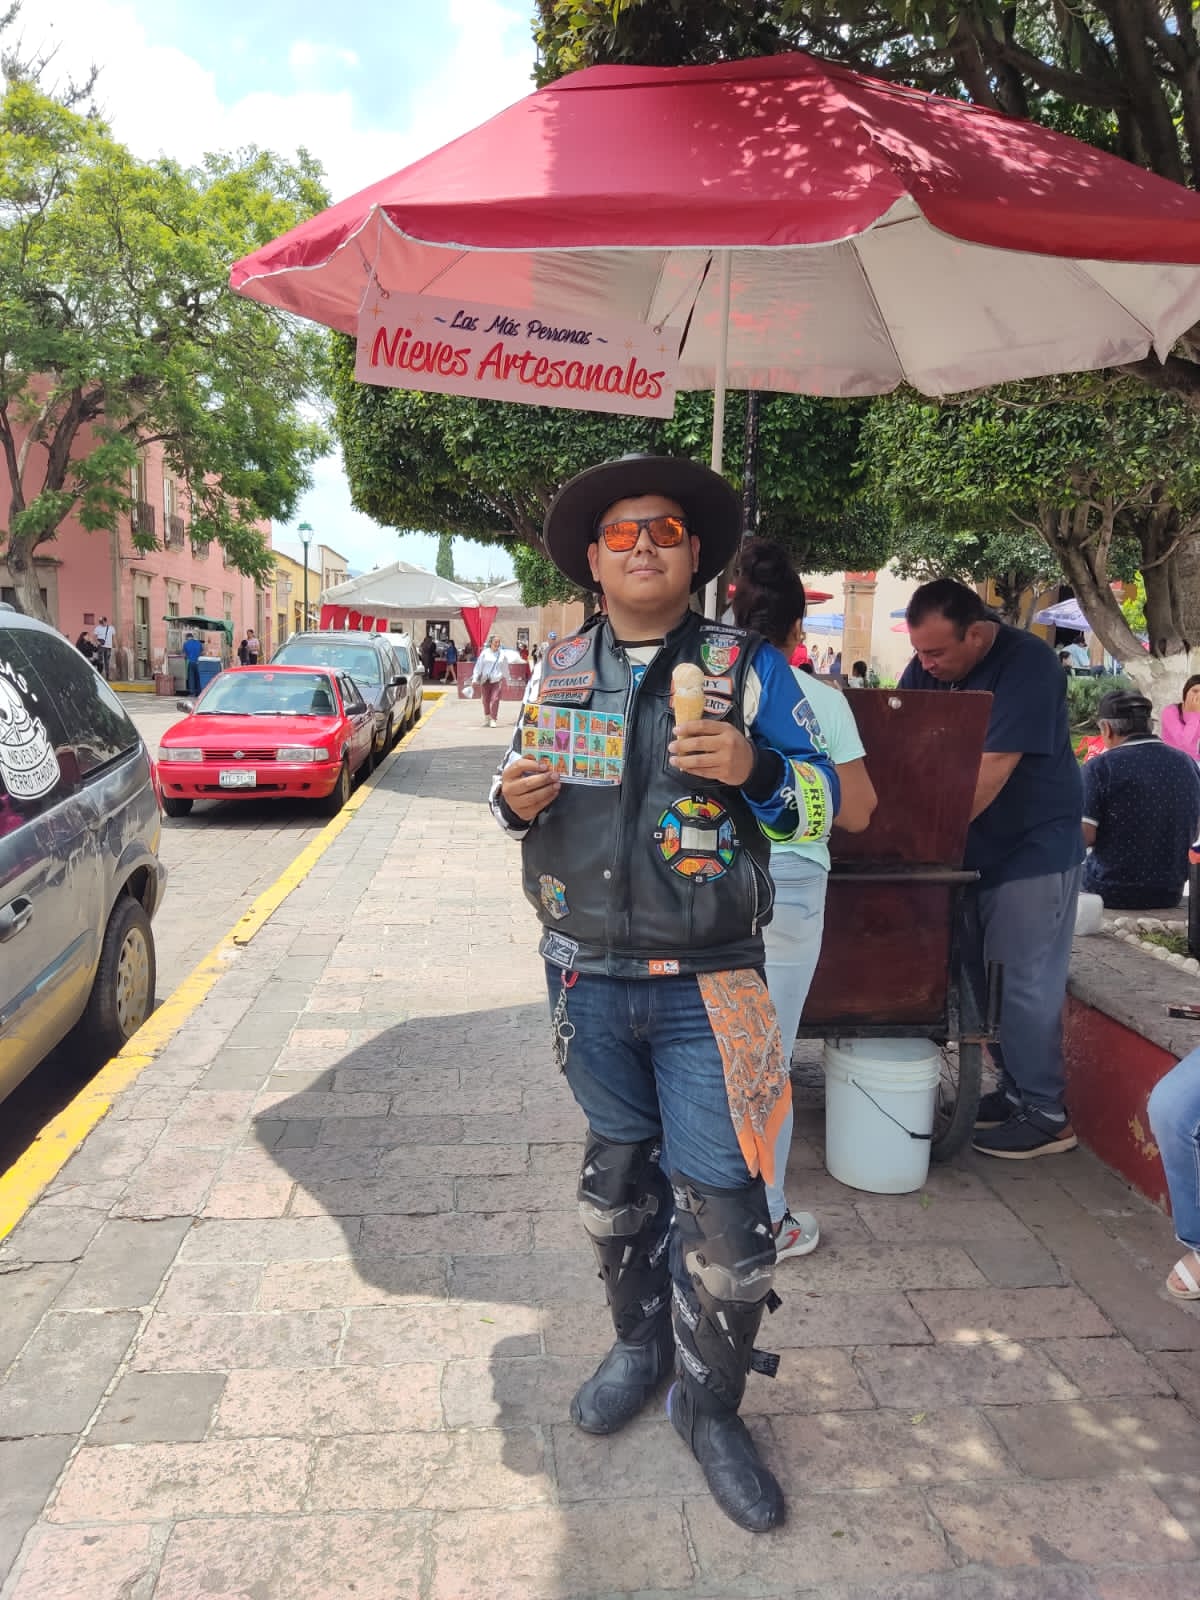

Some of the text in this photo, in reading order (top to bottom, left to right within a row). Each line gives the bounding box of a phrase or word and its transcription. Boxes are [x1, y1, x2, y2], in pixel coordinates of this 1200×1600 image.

[450, 310, 593, 345] Las Más Perronas
[369, 326, 666, 400] Nieves Artesanales
[7, 748, 32, 765] NIEVES
[8, 758, 56, 791] PERRO TRAIDOR
